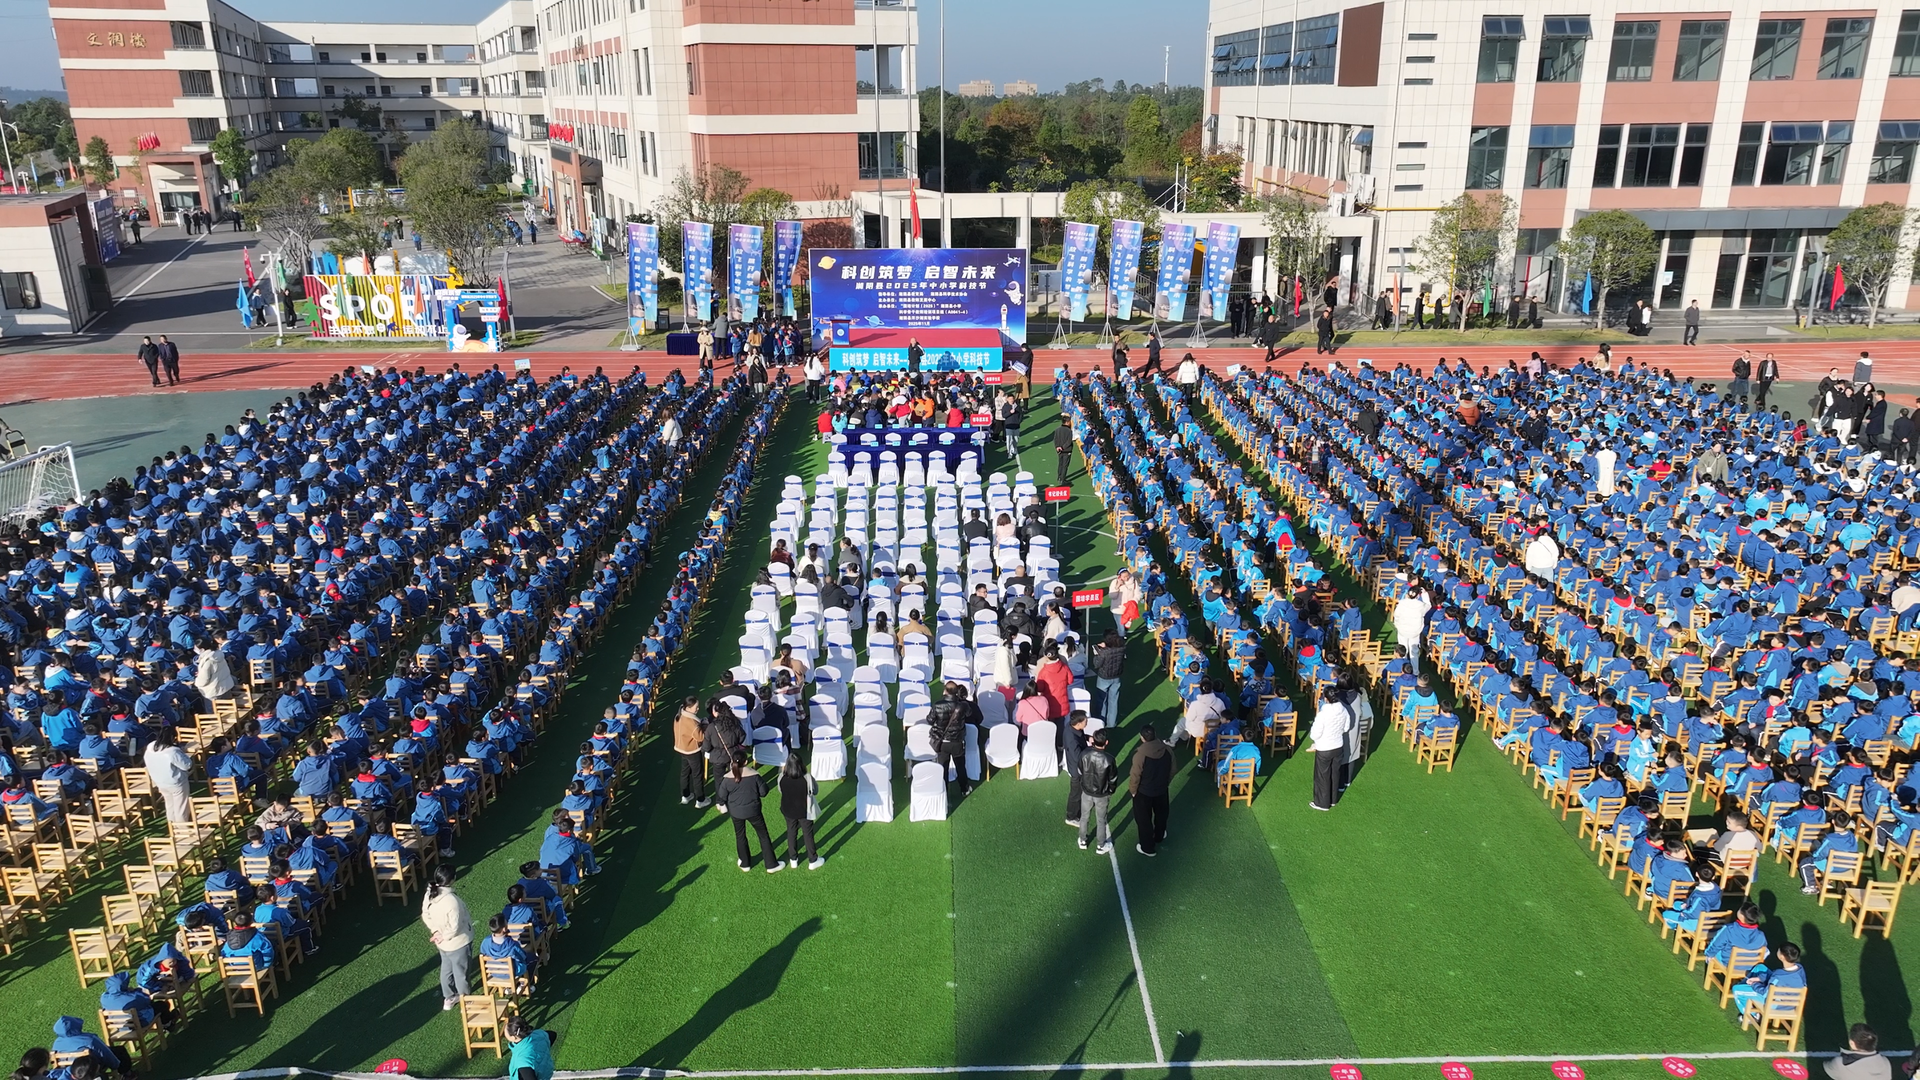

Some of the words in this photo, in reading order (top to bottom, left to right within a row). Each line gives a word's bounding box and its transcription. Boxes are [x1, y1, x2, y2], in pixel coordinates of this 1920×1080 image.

[841, 265, 912, 280] 科创筑梦
[924, 265, 996, 280] 启智未来
[842, 352, 869, 366] 科创筑梦
[1075, 594, 1099, 603] 国培学员区
